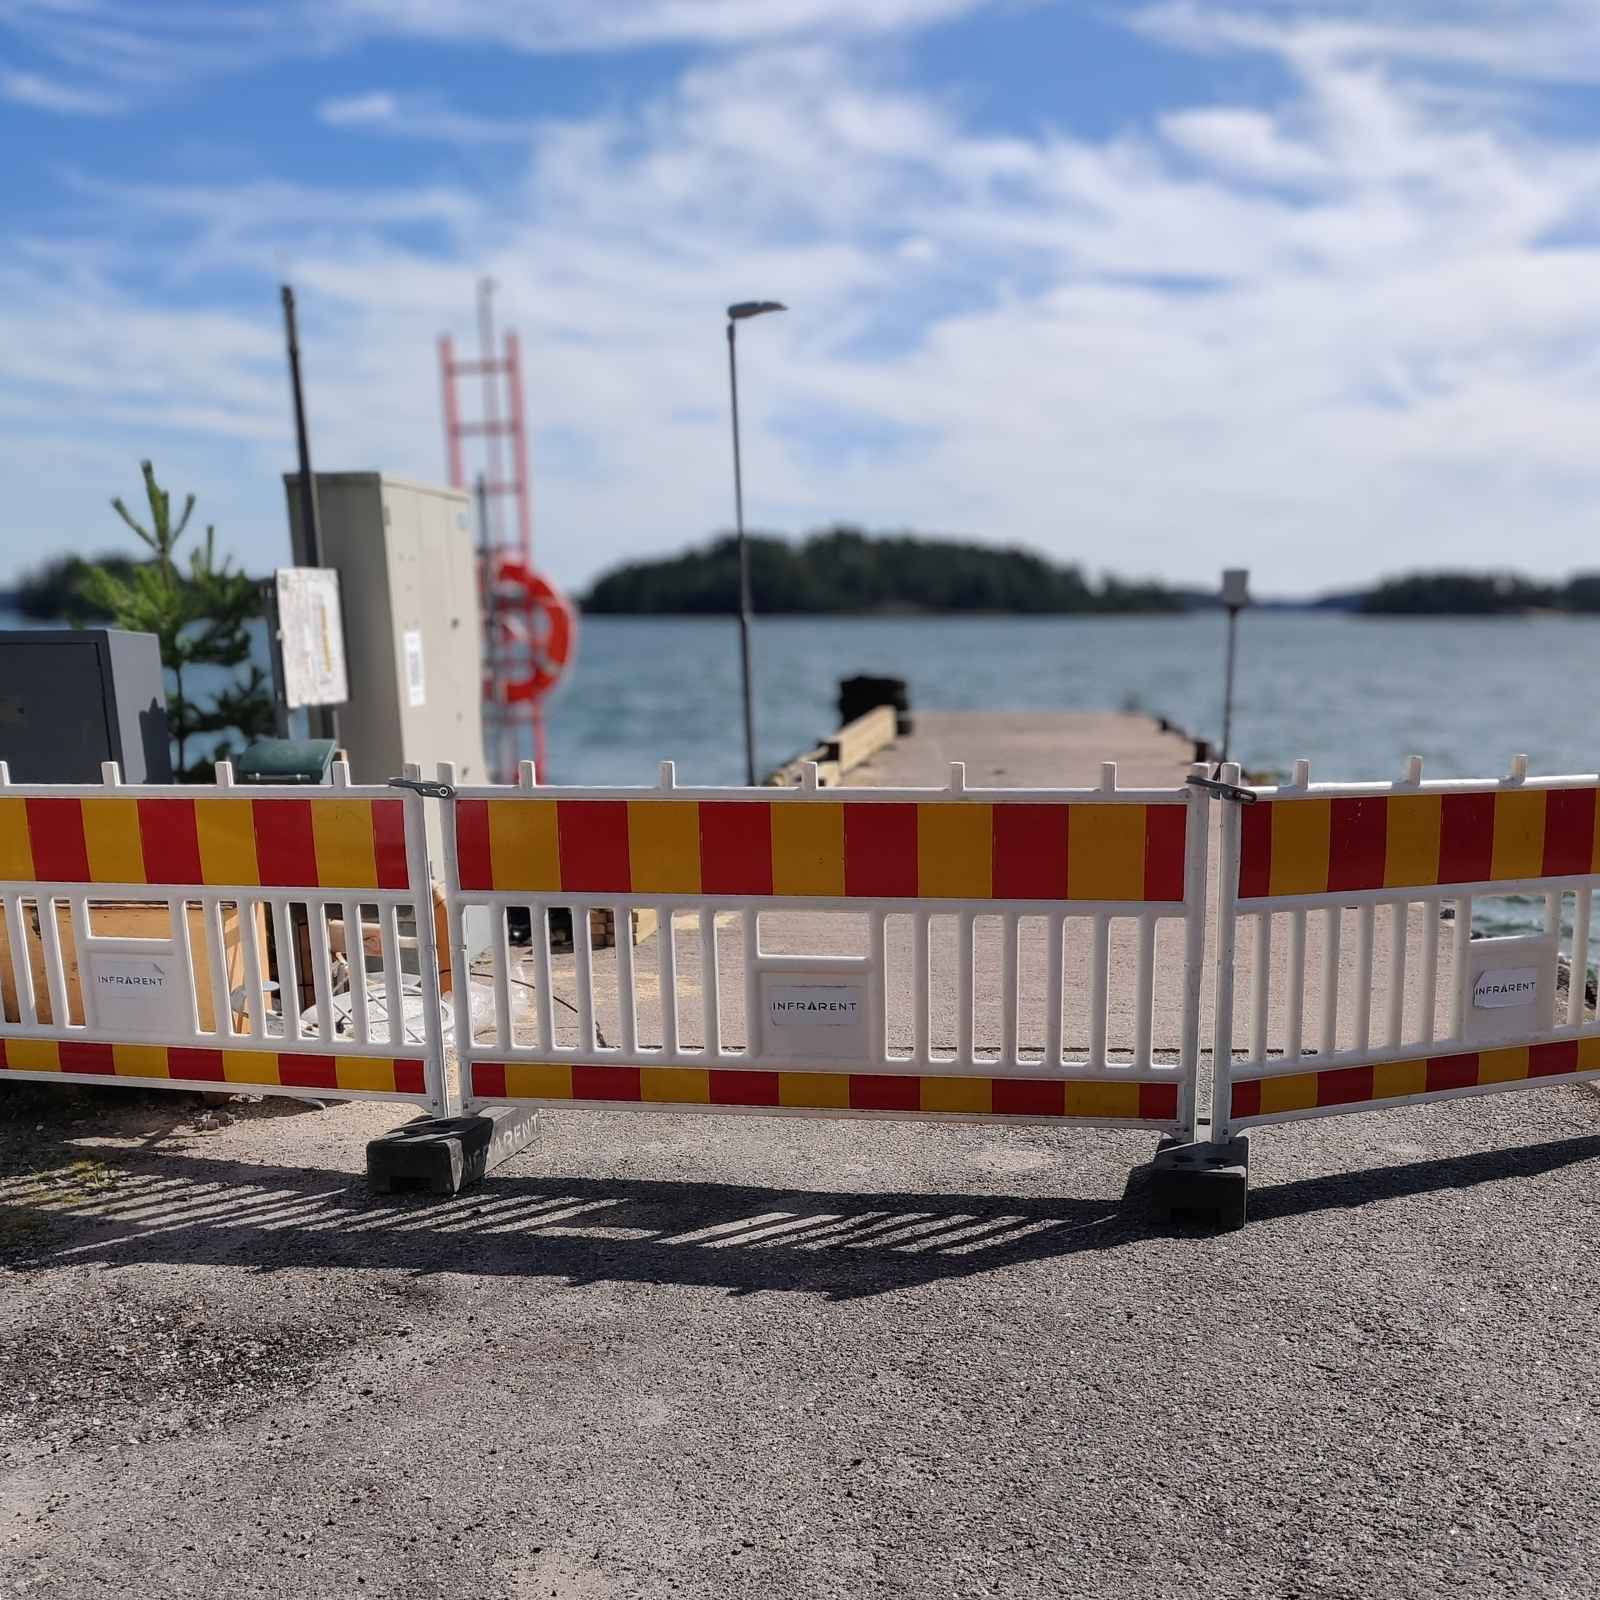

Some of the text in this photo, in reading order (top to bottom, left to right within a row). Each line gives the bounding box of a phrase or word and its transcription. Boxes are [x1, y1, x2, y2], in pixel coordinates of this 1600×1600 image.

[97, 976, 163, 986] INFRARENT
[1475, 982, 1536, 995] INFRARENT
[772, 1001, 857, 1011] INFRARENT
